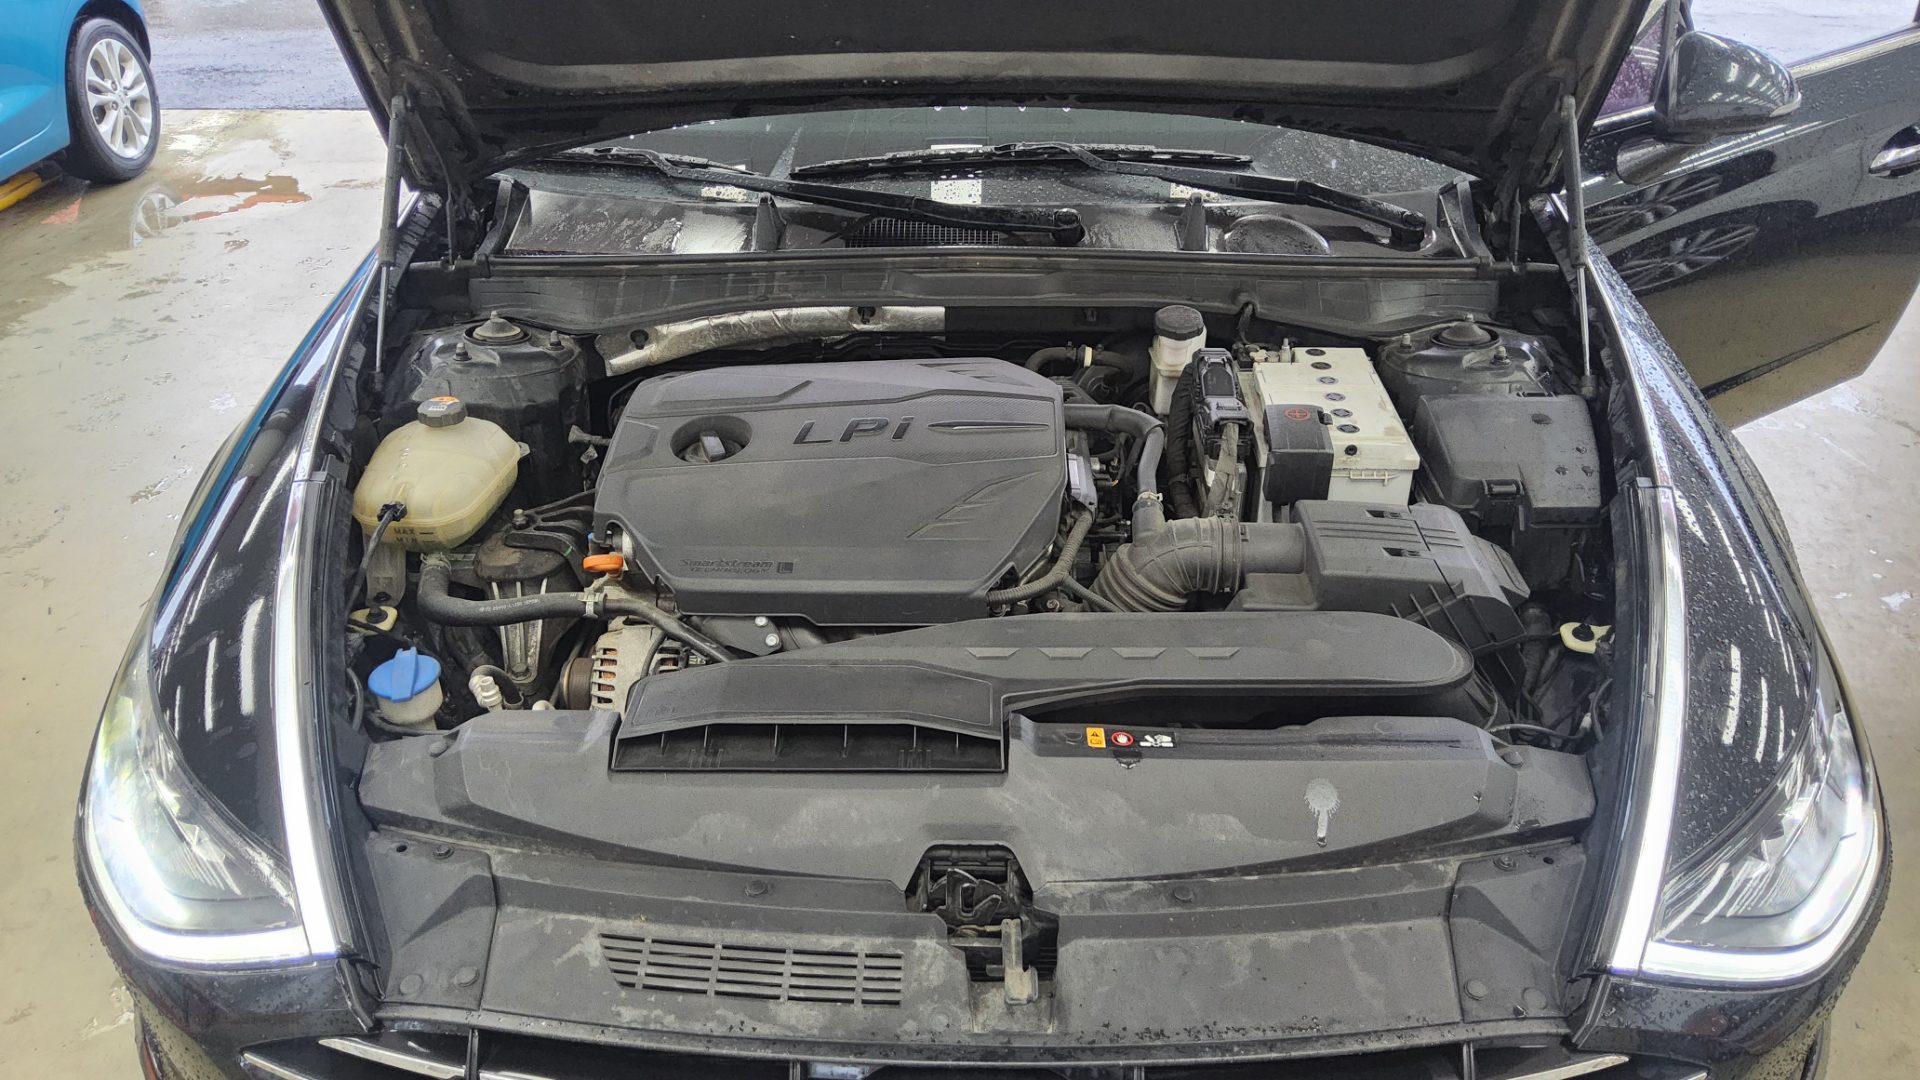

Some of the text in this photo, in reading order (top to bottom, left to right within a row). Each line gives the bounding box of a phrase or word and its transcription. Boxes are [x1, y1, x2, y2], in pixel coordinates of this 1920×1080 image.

[792, 416, 914, 444] LPi
[393, 527, 415, 535] MAX
[680, 559, 774, 568] Smartstream
